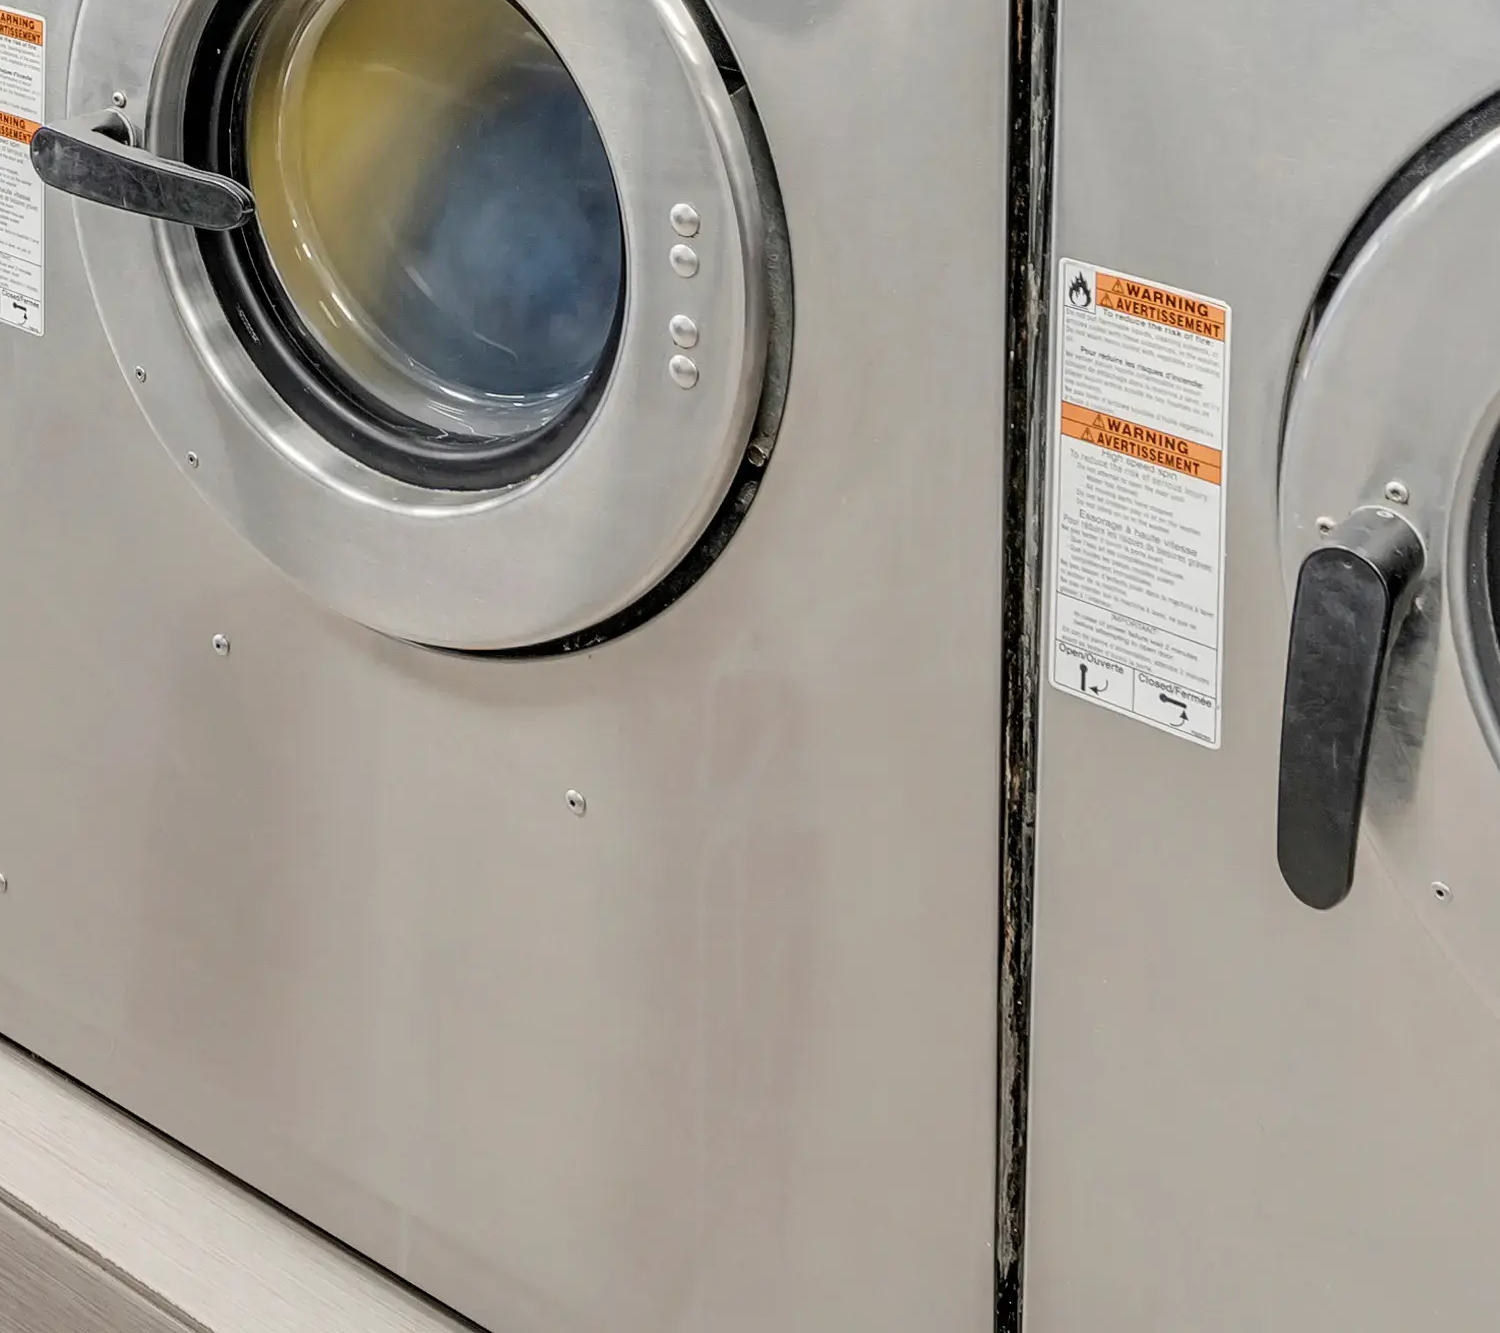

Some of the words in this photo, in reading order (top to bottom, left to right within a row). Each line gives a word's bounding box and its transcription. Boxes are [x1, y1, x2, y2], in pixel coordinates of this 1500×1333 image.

[1116, 298, 1221, 338] AVERTISSEMENT
[1126, 282, 1209, 317] WARNING
[1097, 433, 1200, 475] AVERTISSEMENT
[1107, 418, 1188, 455] WARNING
[1058, 642, 1125, 675] Open/Ouverte
